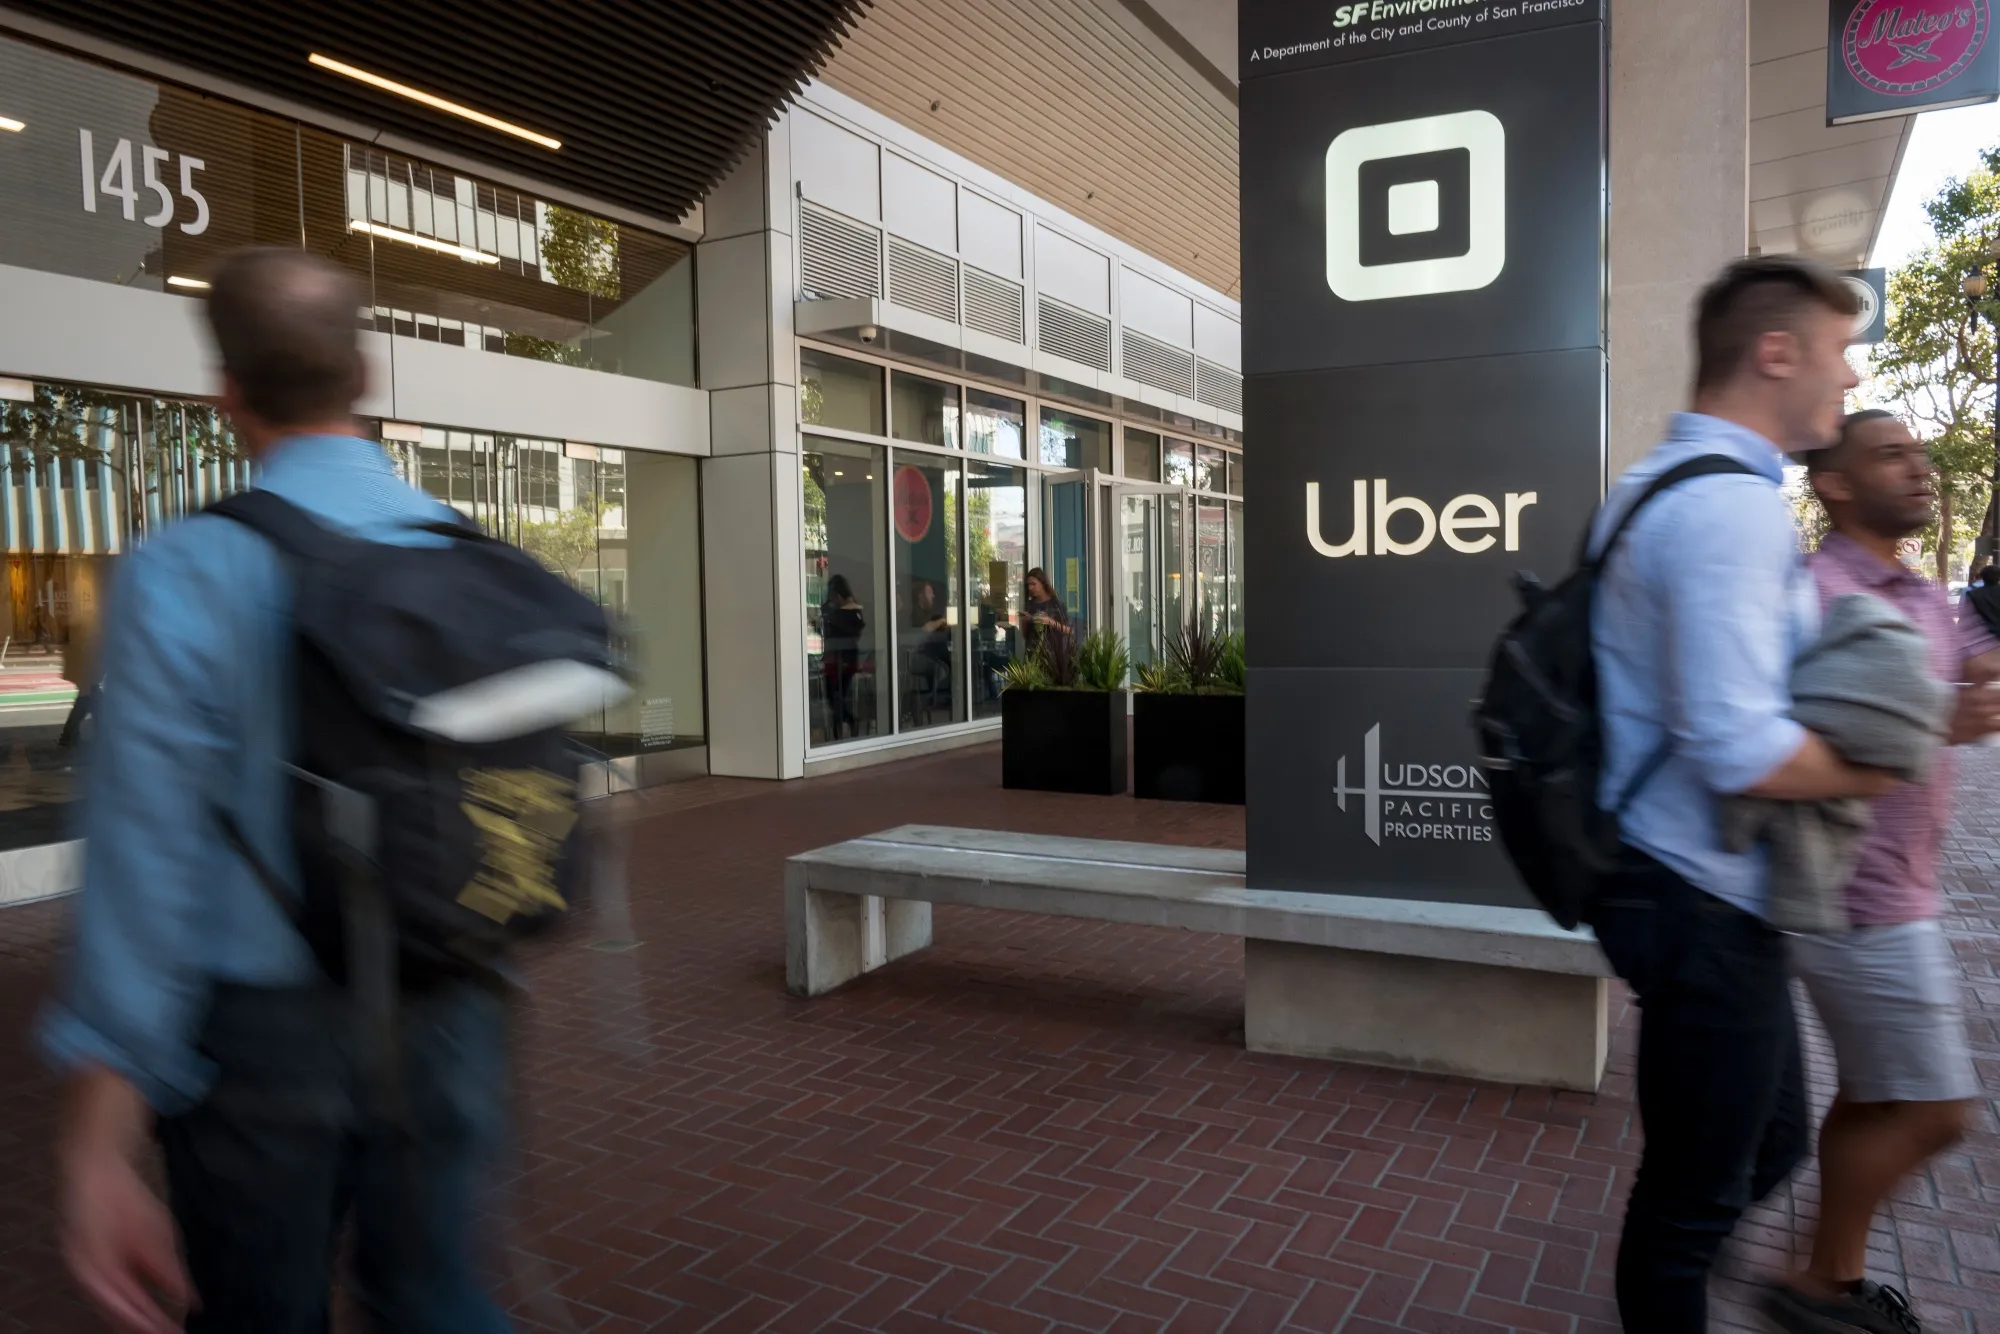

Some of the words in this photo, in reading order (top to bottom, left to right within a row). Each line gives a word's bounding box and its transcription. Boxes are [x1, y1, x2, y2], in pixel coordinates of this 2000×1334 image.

[1250, 49, 1260, 62] A
[1263, 37, 1330, 60] Department
[1333, 32, 1346, 47] of
[1349, 31, 1367, 45] the
[1370, 27, 1395, 41] City
[1399, 19, 1423, 36] and
[1427, 14, 1471, 31] County
[1475, 7, 1489, 22] of
[1492, 6, 1517, 19] San
[1522, 0, 1585, 14] Francisco
[1858, 5, 1973, 48] Mateo's
[79, 127, 210, 236] 1455
[1306, 478, 1537, 558] Uber
[1384, 800, 1494, 820] PACIFIC
[1384, 821, 1492, 842] PROPERTIES
